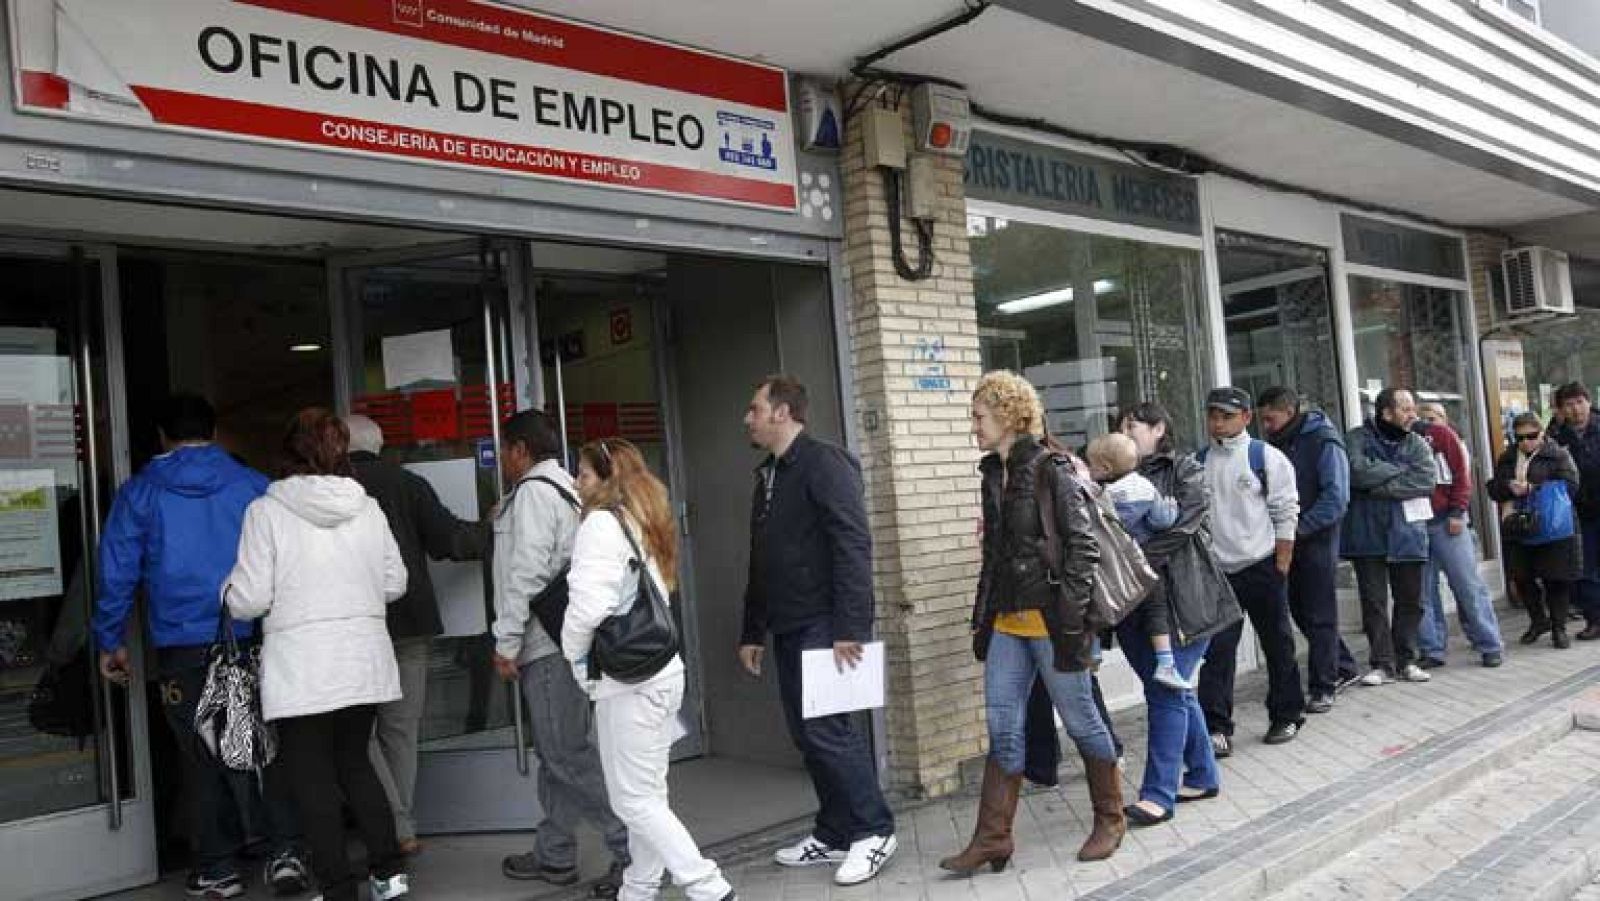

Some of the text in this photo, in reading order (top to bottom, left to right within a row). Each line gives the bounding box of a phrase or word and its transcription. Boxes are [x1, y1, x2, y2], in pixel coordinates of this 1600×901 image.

[427, 9, 564, 48] Comunidad de Madrid
[198, 26, 704, 151] OFICINA DE EMPLEO
[321, 120, 641, 180] CONSEJERÍA DE EDUCACIÓN Y EMPLEO
